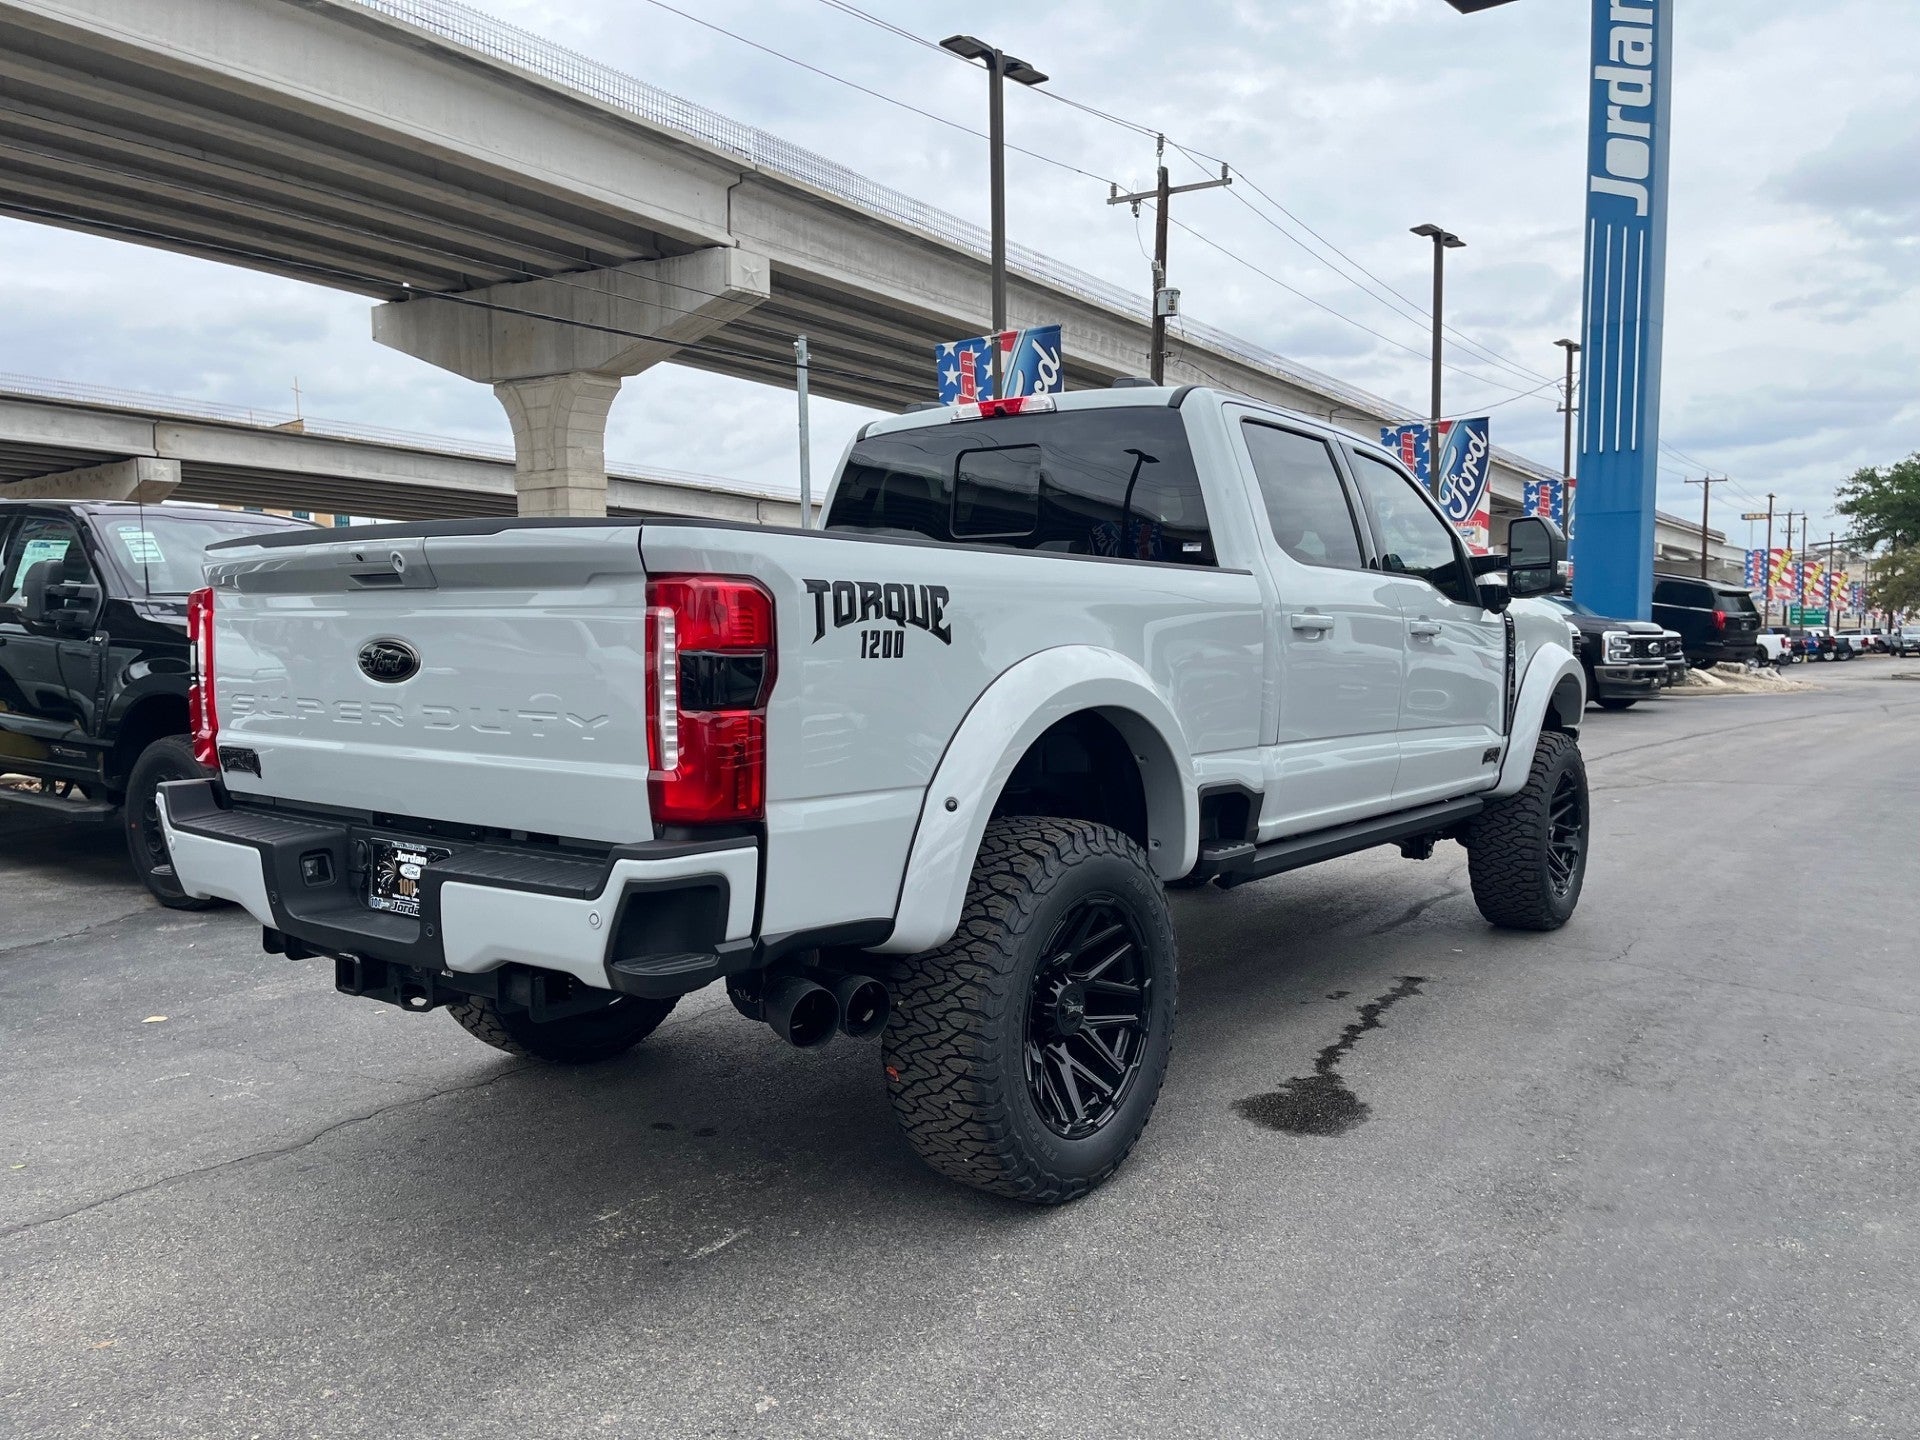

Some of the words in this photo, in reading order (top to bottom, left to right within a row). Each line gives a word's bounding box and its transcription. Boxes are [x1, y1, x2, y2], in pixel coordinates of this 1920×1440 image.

[1438, 425, 1488, 519] Ford
[802, 578, 952, 646] TORQUE
[860, 630, 905, 659] 1200
[367, 647, 402, 672] Ford
[423, 704, 610, 740] DUTY
[395, 850, 427, 866] Jordan
[391, 901, 420, 915] Jorda
